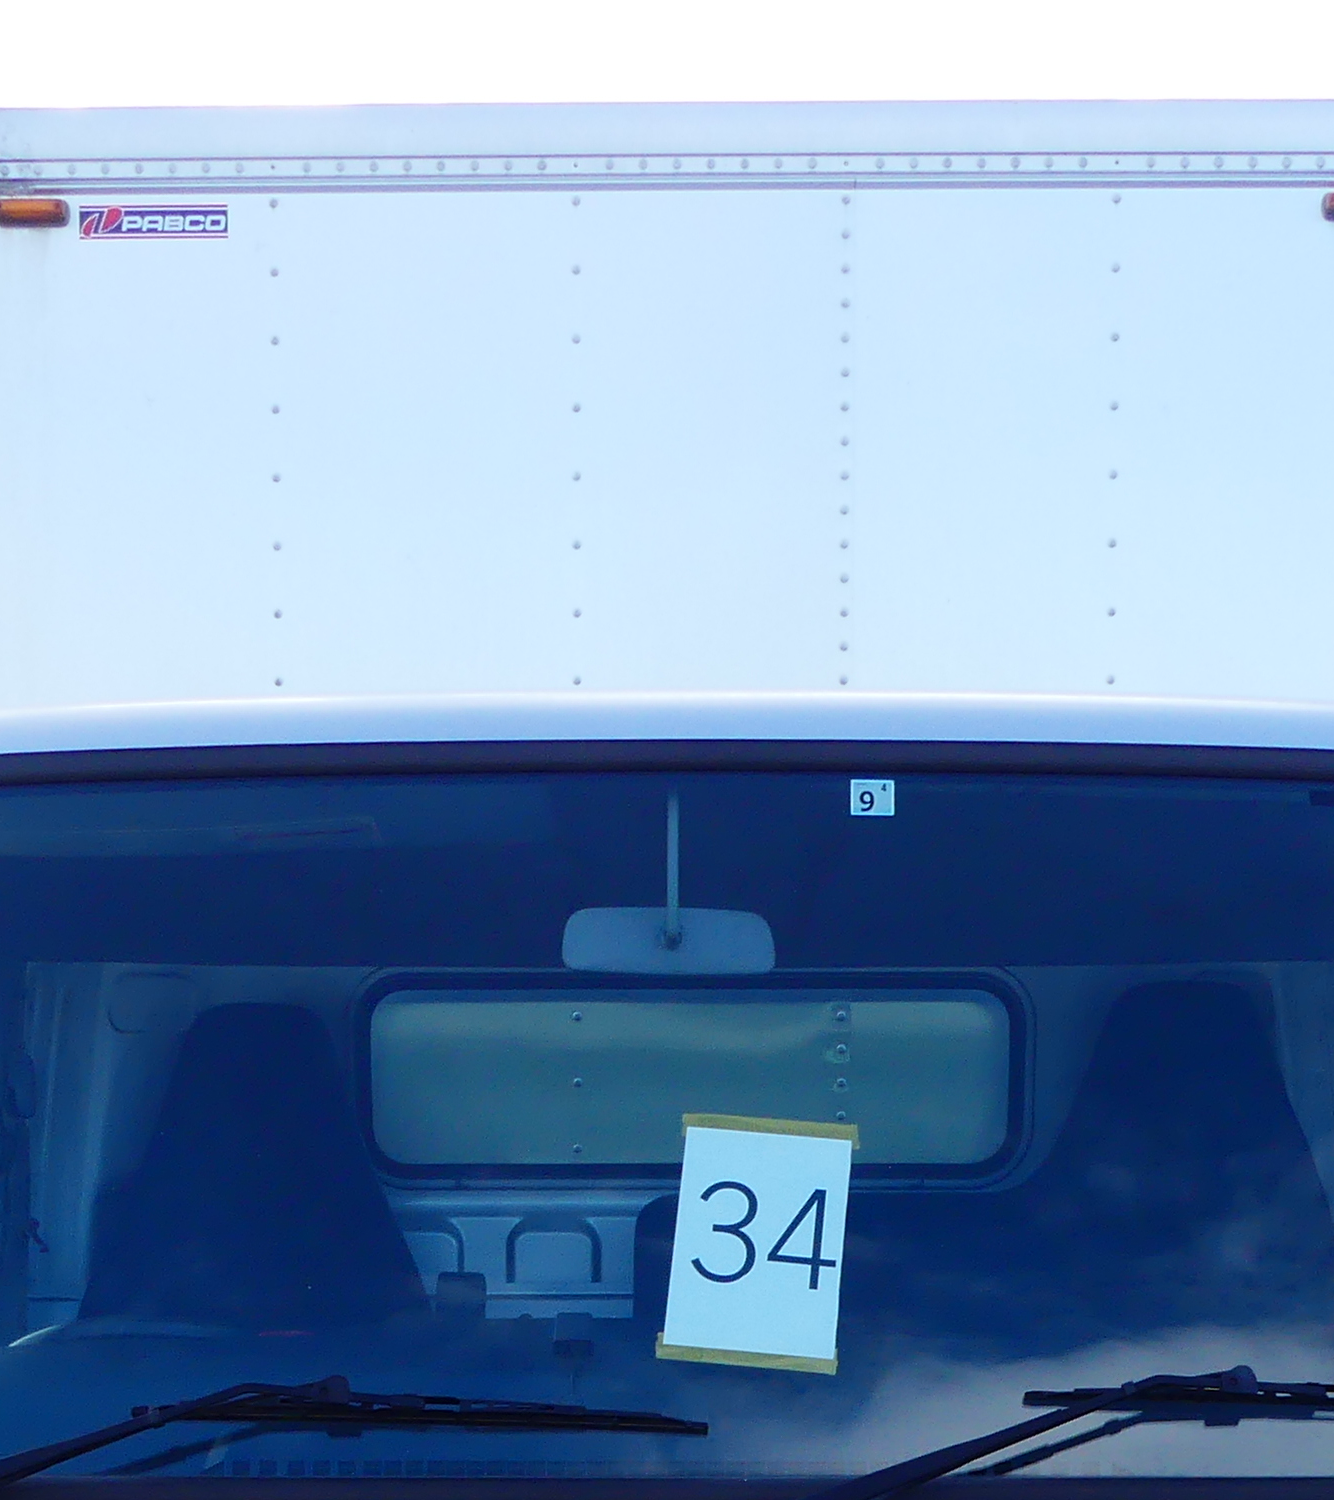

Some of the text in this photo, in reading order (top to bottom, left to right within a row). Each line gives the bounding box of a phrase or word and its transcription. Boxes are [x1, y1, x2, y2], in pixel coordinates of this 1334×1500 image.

[121, 214, 227, 232] PABCO
[859, 790, 875, 812] 9
[690, 1180, 837, 1291] 34
